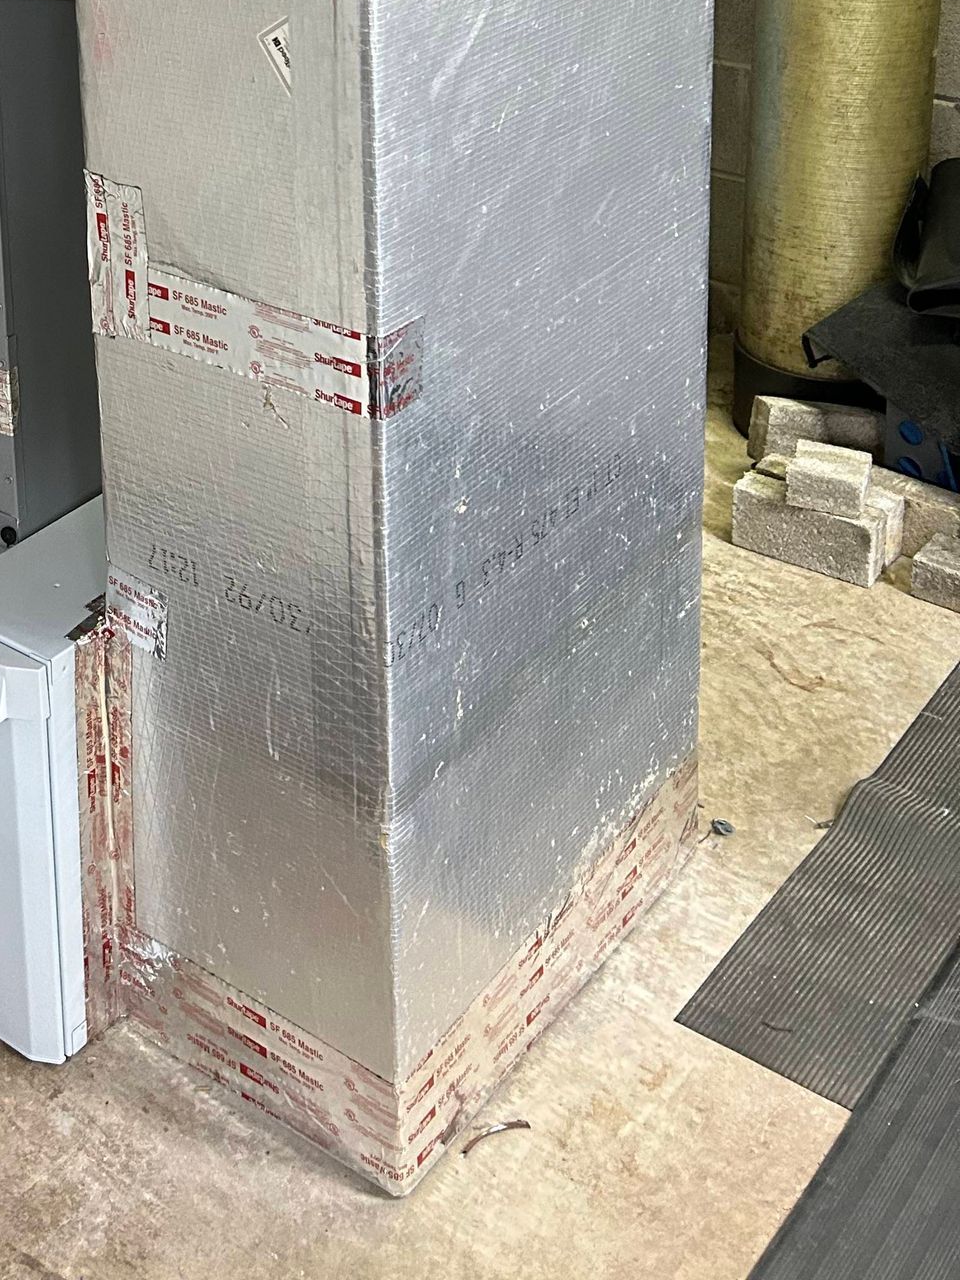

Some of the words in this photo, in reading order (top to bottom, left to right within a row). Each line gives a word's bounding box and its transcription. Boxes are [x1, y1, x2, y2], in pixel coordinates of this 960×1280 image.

[95, 195, 103, 209] SF
[120, 201, 131, 232] Mastic
[99, 222, 110, 263] Shurtape
[123, 235, 132, 251] 685
[125, 253, 132, 266] SF
[126, 278, 136, 320] Shurtape
[172, 290, 183, 301] SF
[184, 294, 199, 307] 685
[200, 299, 227, 316] Mastic
[173, 324, 185, 335] SF
[186, 329, 200, 342] 685
[202, 334, 229, 351] Mastic
[314, 352, 353, 374] Shurtape
[315, 388, 354, 410] Shurtape
[148, 545, 200, 587] 12:17
[108, 575, 119, 586] SF
[119, 582, 132, 595] 685
[227, 996, 260, 1023] Shurtape
[269, 1021, 280, 1033] SF
[282, 1029, 296, 1044] 685
[297, 1039, 324, 1061] Mastic
[212, 1048, 225, 1063] 685
[226, 1058, 237, 1070] SF
[270, 1051, 281, 1063] SF
[282, 1059, 296, 1074] 685
[298, 1068, 324, 1091] Mastic
[405, 1164, 415, 1178] SF
